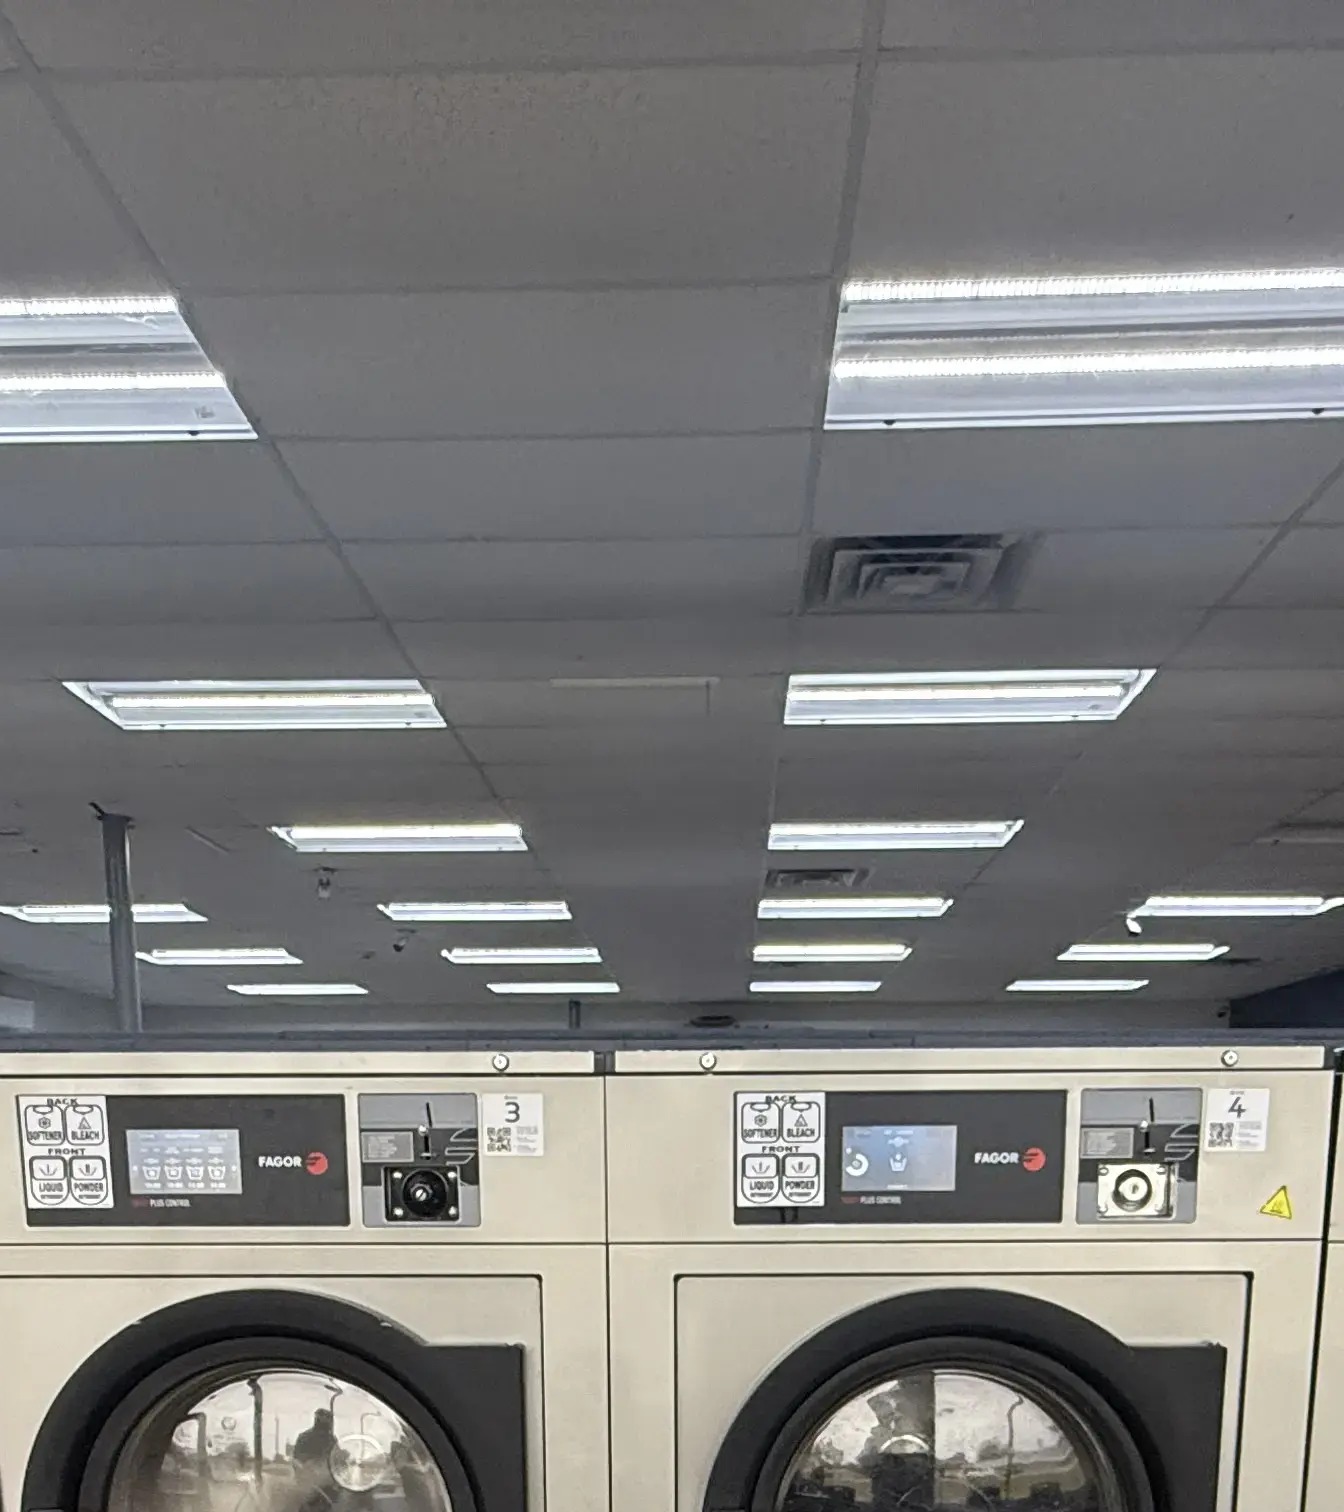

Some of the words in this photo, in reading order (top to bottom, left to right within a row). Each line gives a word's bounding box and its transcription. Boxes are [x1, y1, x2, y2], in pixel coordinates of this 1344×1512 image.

[47, 1098, 78, 1106] BACK
[765, 1095, 797, 1103] BACK
[504, 1101, 521, 1123] 3
[1228, 1096, 1247, 1119] 4
[71, 1131, 100, 1140] BLEACH
[743, 1128, 777, 1138] SOFTENER
[787, 1128, 815, 1137] BLEACH
[762, 1145, 800, 1153] FRONT
[258, 1155, 302, 1168] FAGOR
[974, 1151, 1019, 1164] FAGOR
[39, 1182, 64, 1192] LIQUID
[74, 1182, 104, 1192] POWDER
[749, 1180, 774, 1191] LIQUID
[785, 1180, 815, 1190] POWDER
